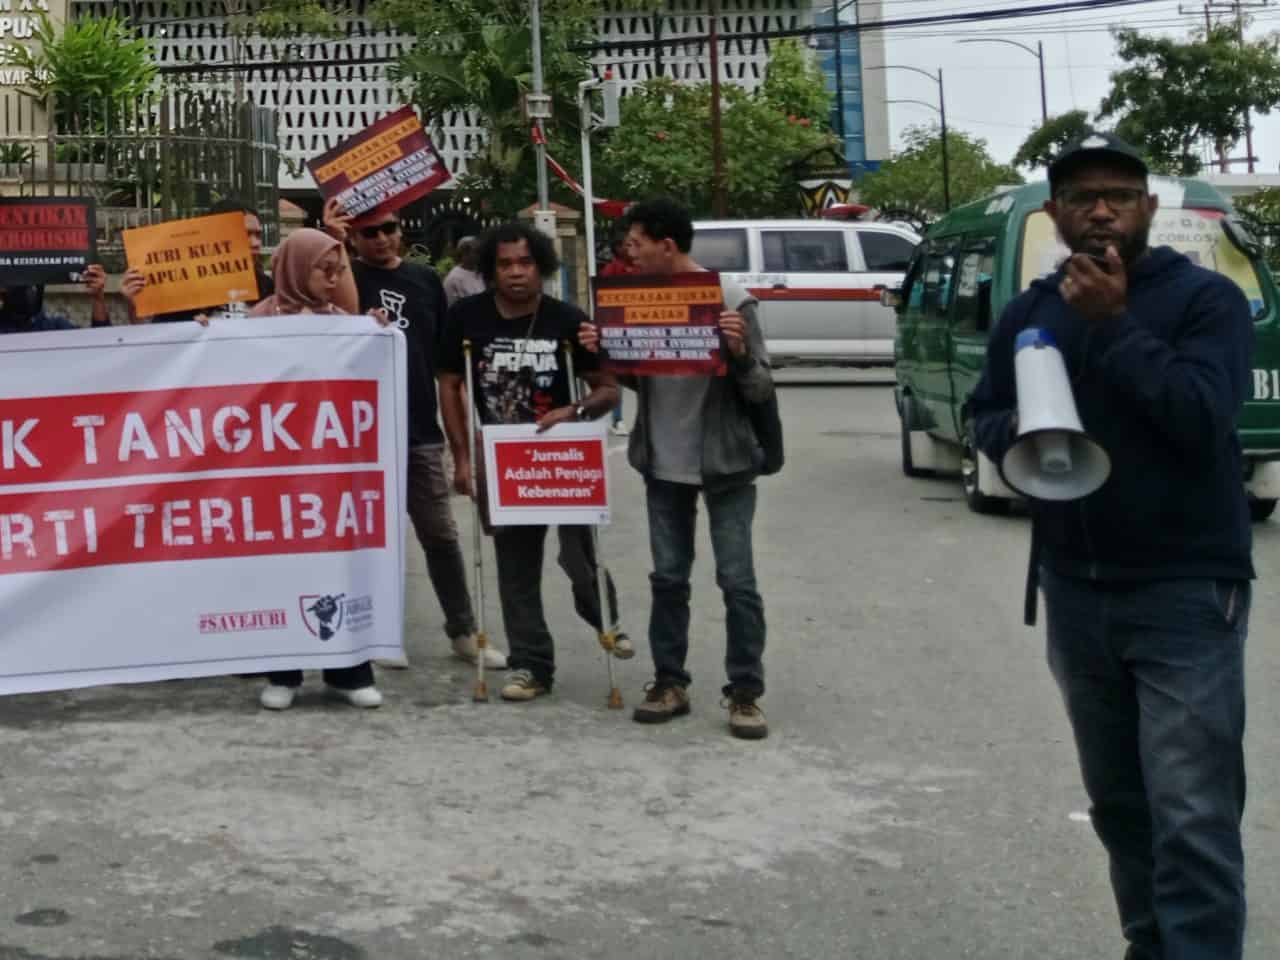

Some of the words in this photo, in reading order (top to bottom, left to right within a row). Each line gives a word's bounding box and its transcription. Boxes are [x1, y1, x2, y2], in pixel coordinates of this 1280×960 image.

[145, 248, 181, 265] JUBI
[187, 240, 232, 259] KUAT
[145, 267, 189, 287] APUA
[197, 257, 249, 278] DAMAI
[73, 399, 376, 466] TANGKAP
[504, 467, 552, 481] Adalah
[126, 490, 381, 549] TERLIBAT
[200, 609, 287, 634] #SAVEJUBI
